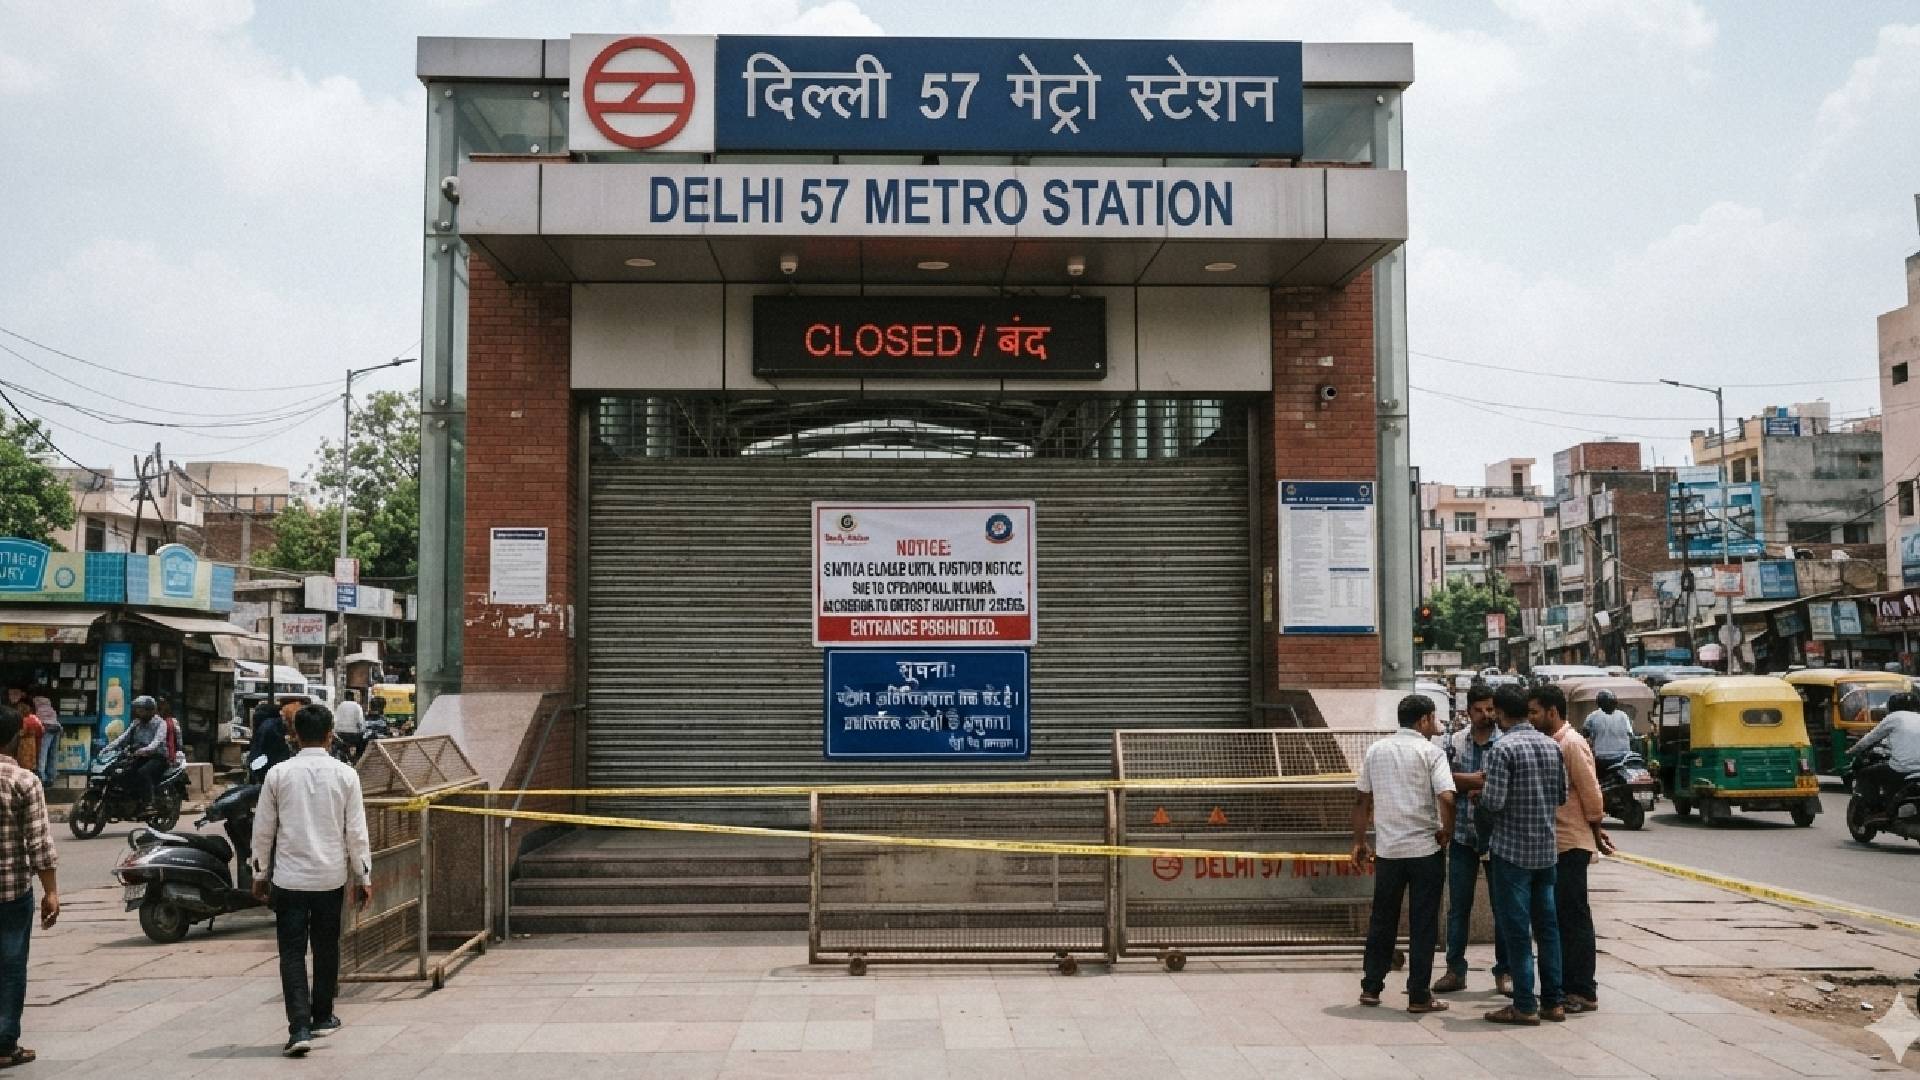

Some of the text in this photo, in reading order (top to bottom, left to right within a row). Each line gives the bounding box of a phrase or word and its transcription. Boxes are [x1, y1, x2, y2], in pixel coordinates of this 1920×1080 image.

[742, 53, 1279, 134] दिल्ली 57 मेट्रो स्टेशन
[650, 176, 1233, 227] DELHI 57 METRO STATION
[804, 323, 962, 358] CLOSED
[996, 314, 1052, 360] बंद
